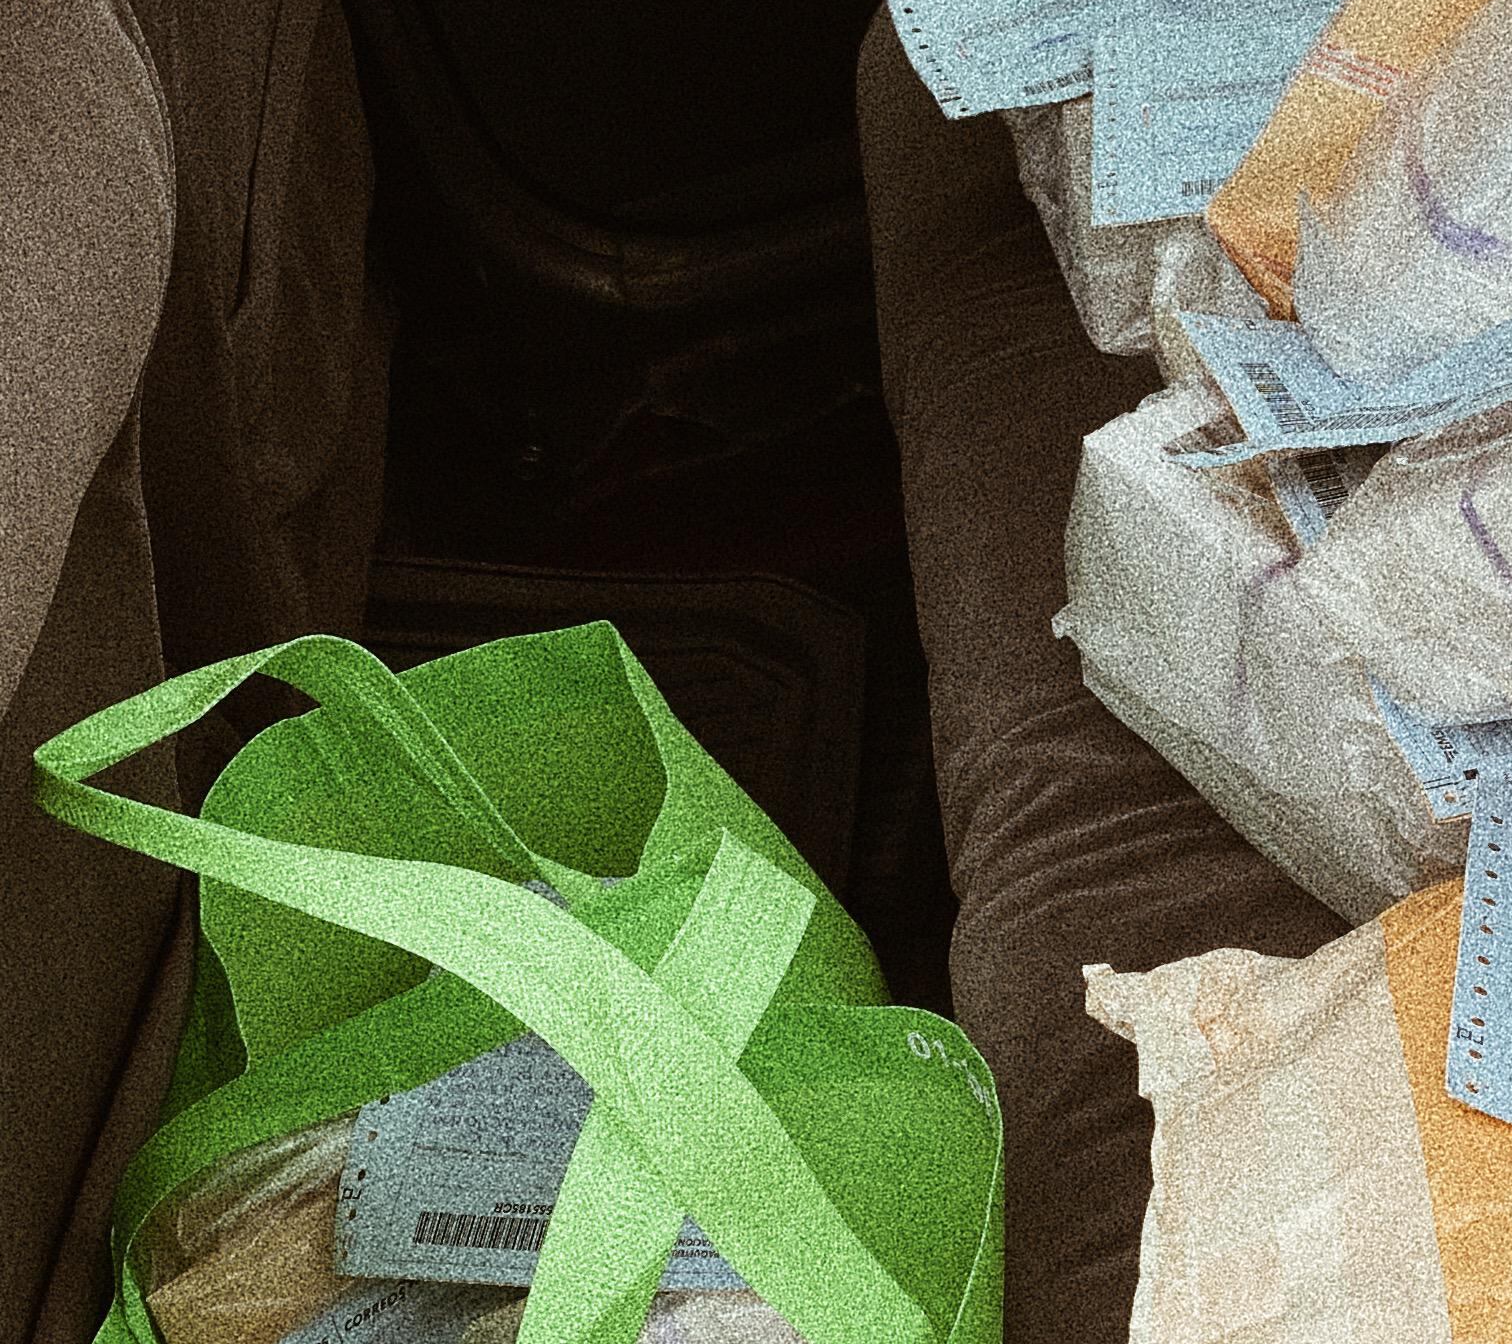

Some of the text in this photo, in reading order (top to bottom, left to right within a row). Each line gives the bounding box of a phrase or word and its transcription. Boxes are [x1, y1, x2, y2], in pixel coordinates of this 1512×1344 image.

[1431, 726, 1453, 753] EMS
[494, 1202, 553, 1215] 555185CR
[343, 1286, 408, 1333] CORREOS
